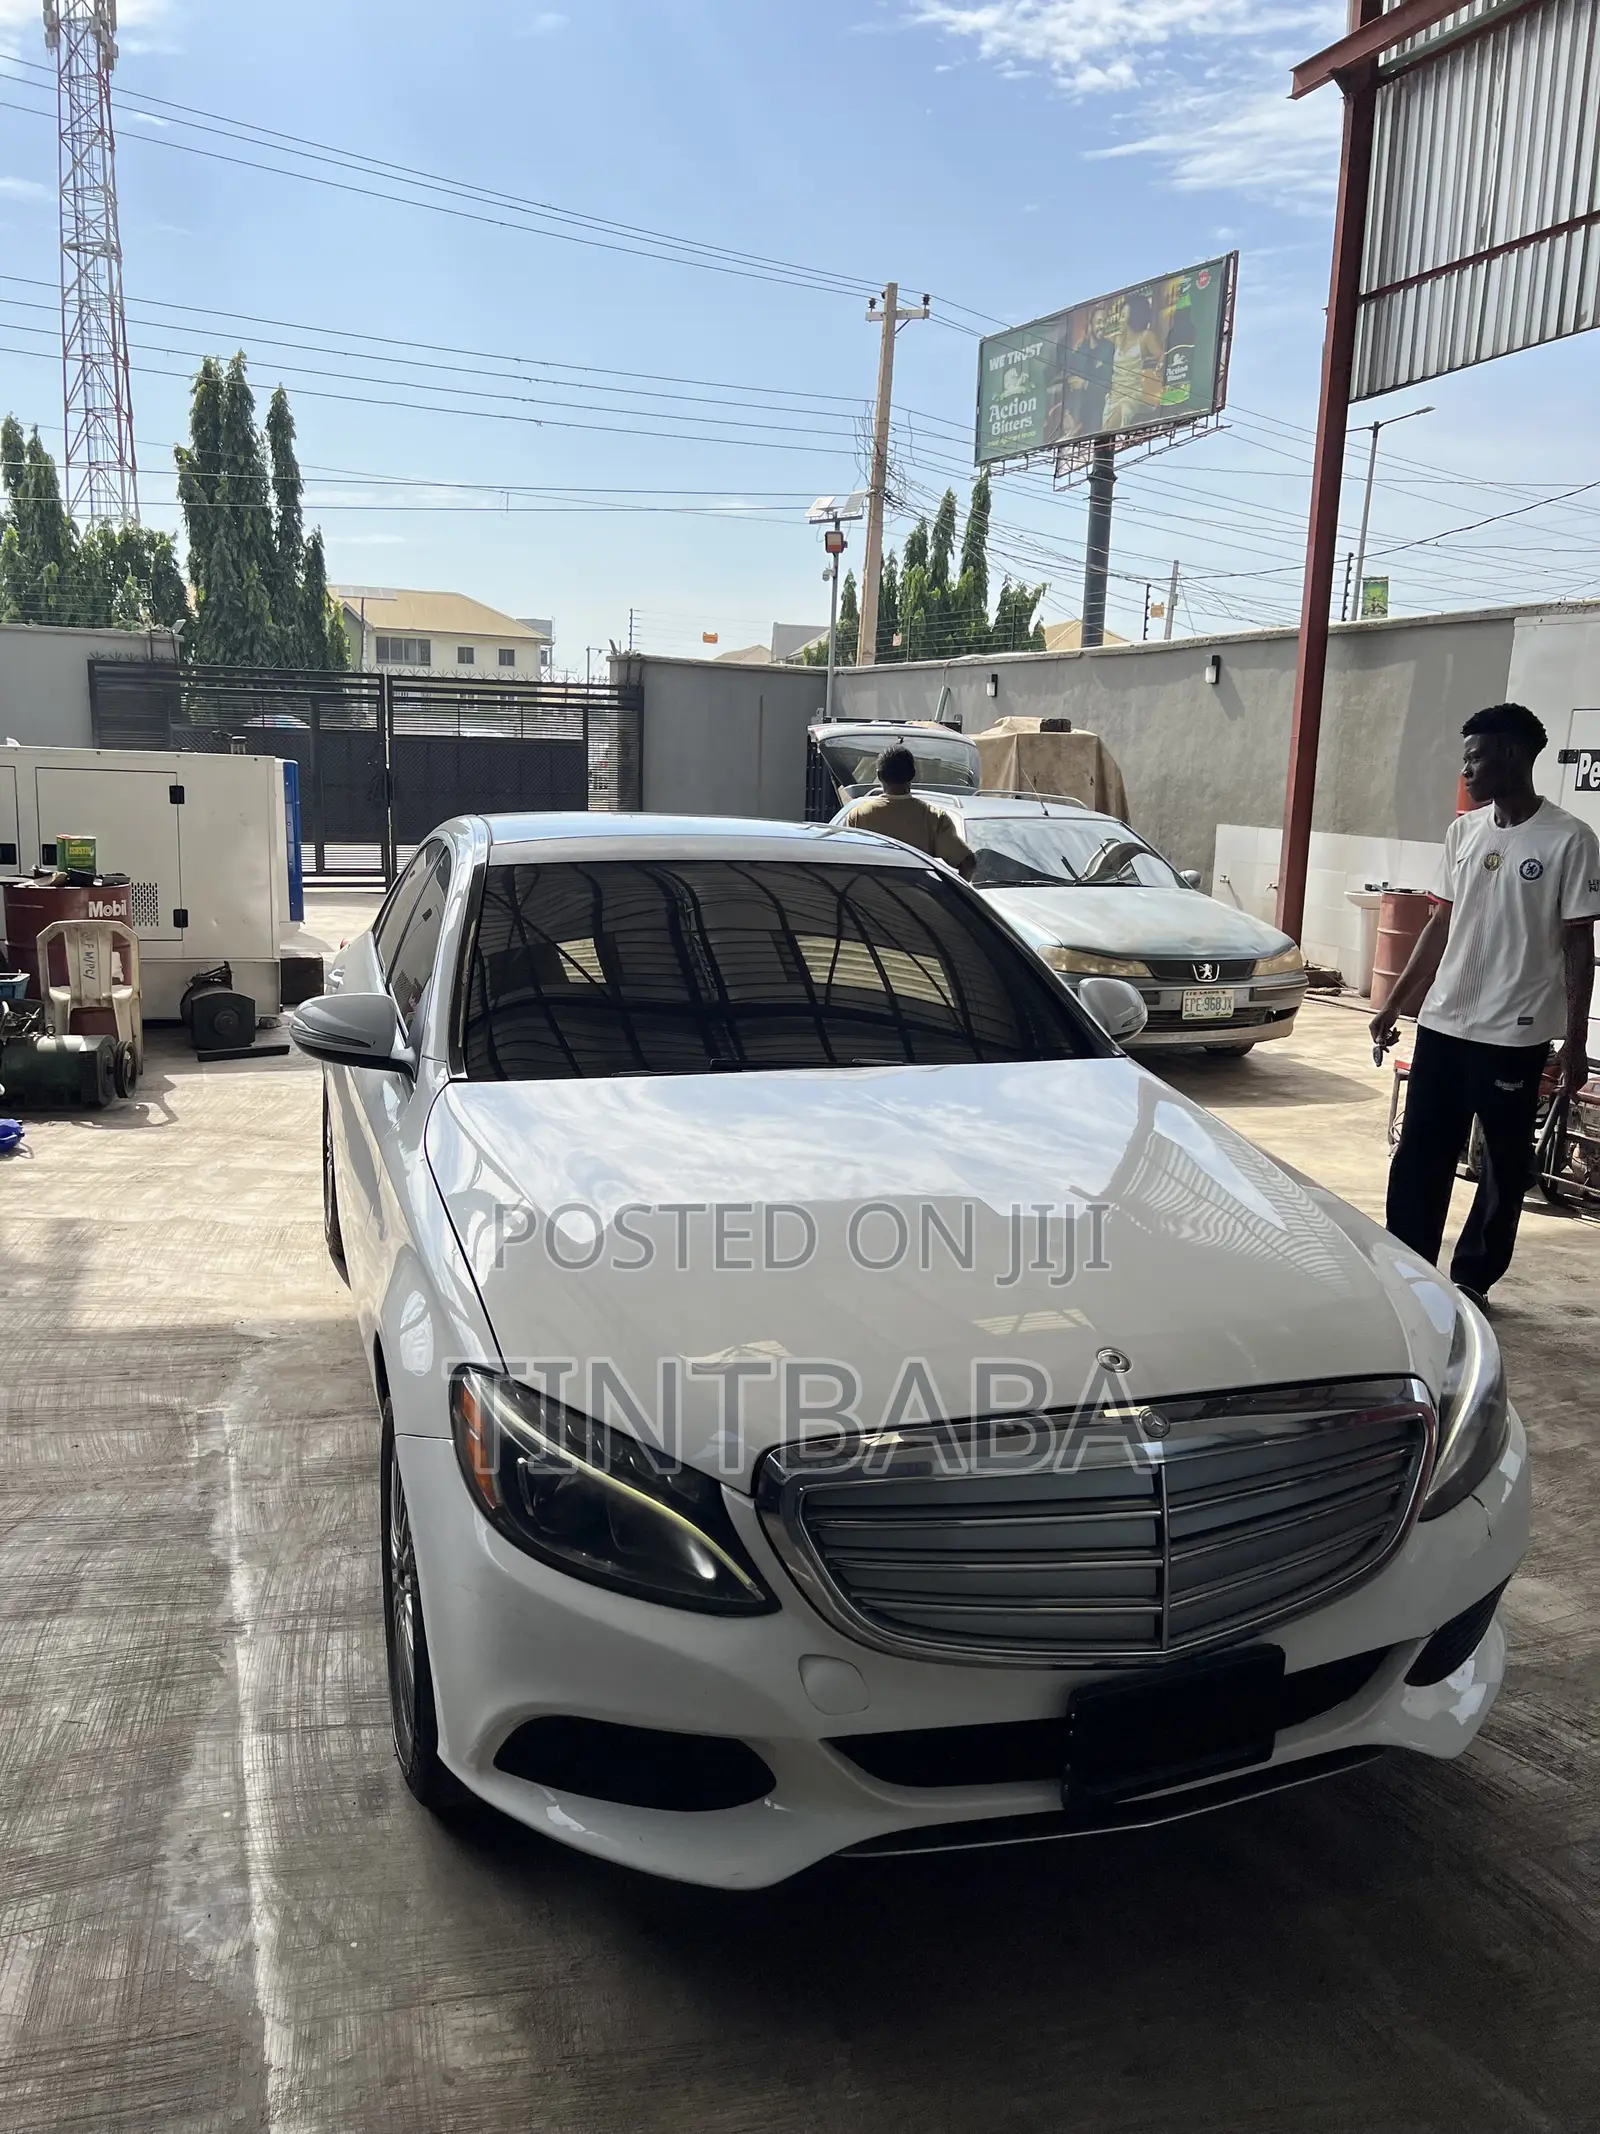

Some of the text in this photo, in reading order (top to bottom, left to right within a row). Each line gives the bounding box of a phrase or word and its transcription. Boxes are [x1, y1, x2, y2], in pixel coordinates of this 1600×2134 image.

[989, 342, 1044, 372] WE TRUST
[988, 397, 1037, 423] Action
[991, 416, 1033, 436] Bitters
[88, 900, 128, 918] Mobil
